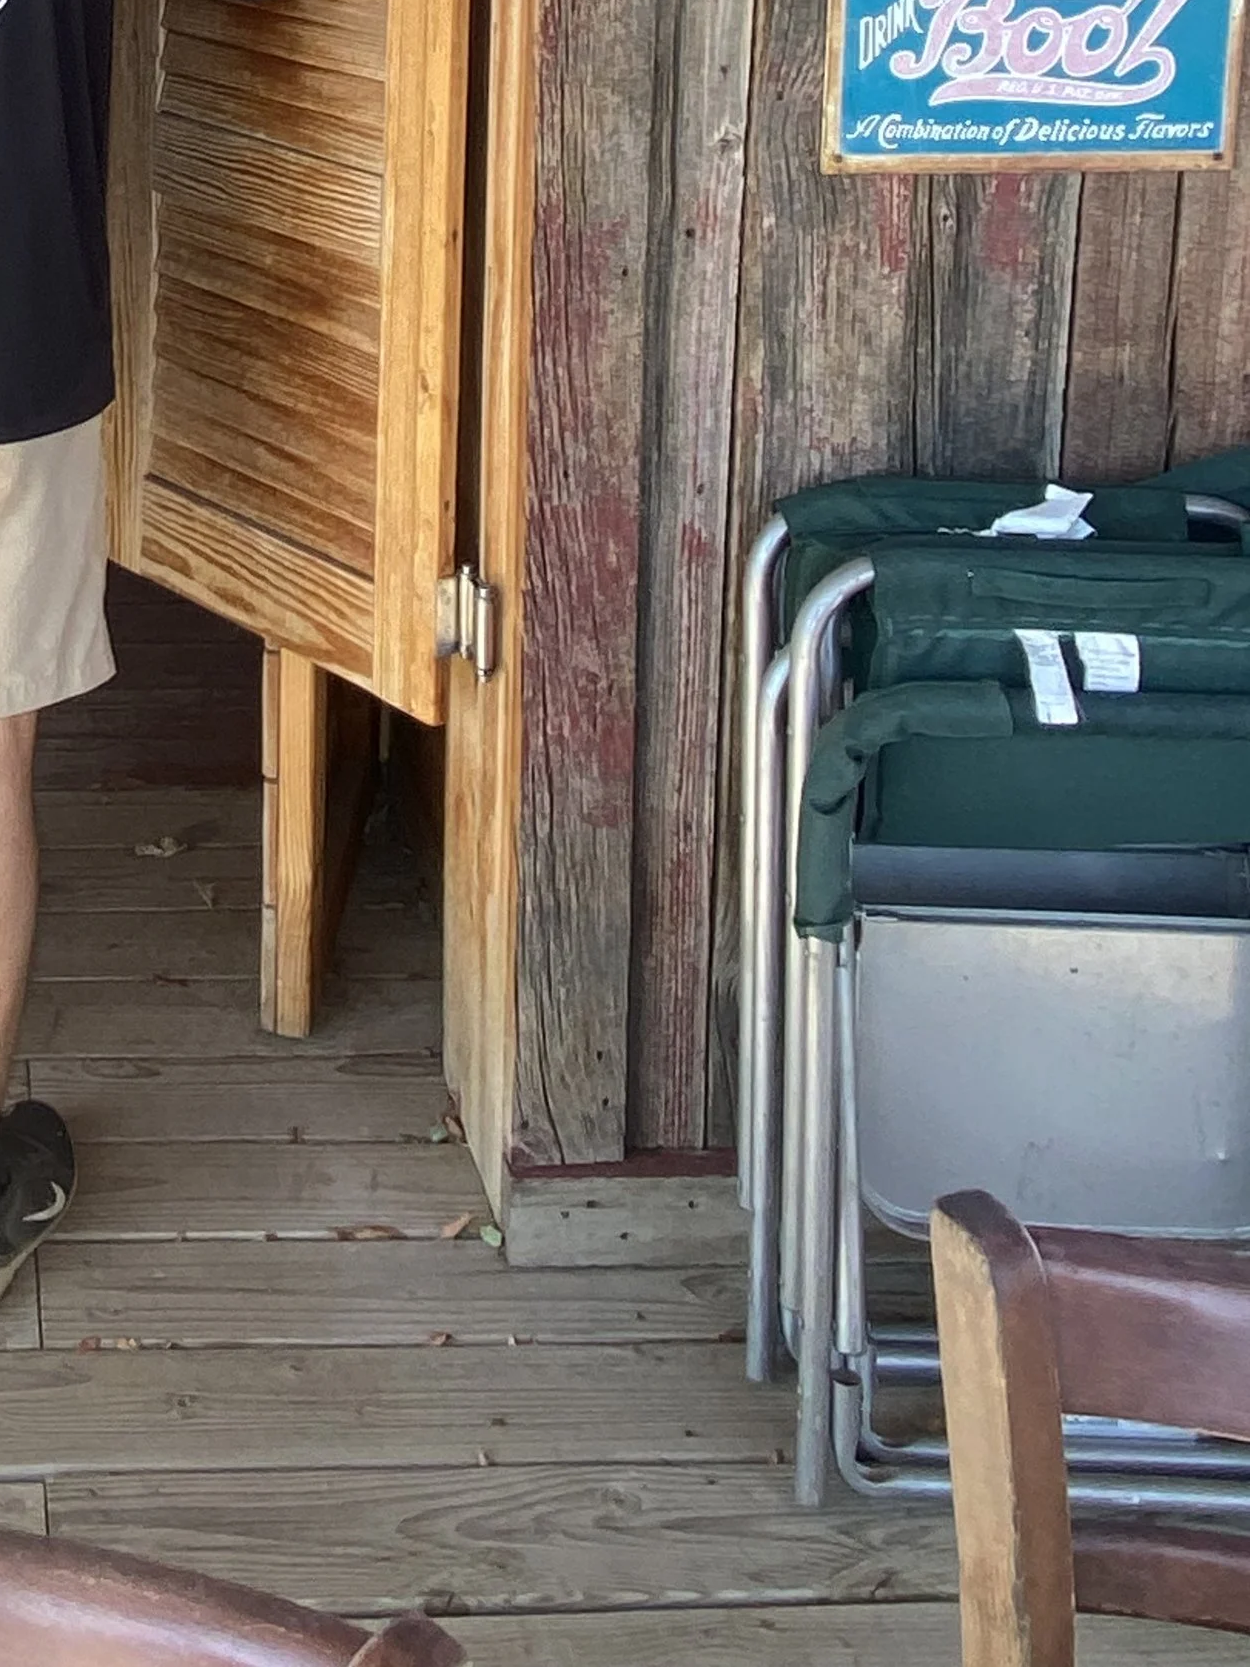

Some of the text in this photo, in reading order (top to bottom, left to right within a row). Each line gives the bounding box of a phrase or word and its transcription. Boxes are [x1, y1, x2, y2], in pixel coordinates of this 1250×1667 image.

[847, 113, 1215, 150] A Combination of Delicious Flavors
